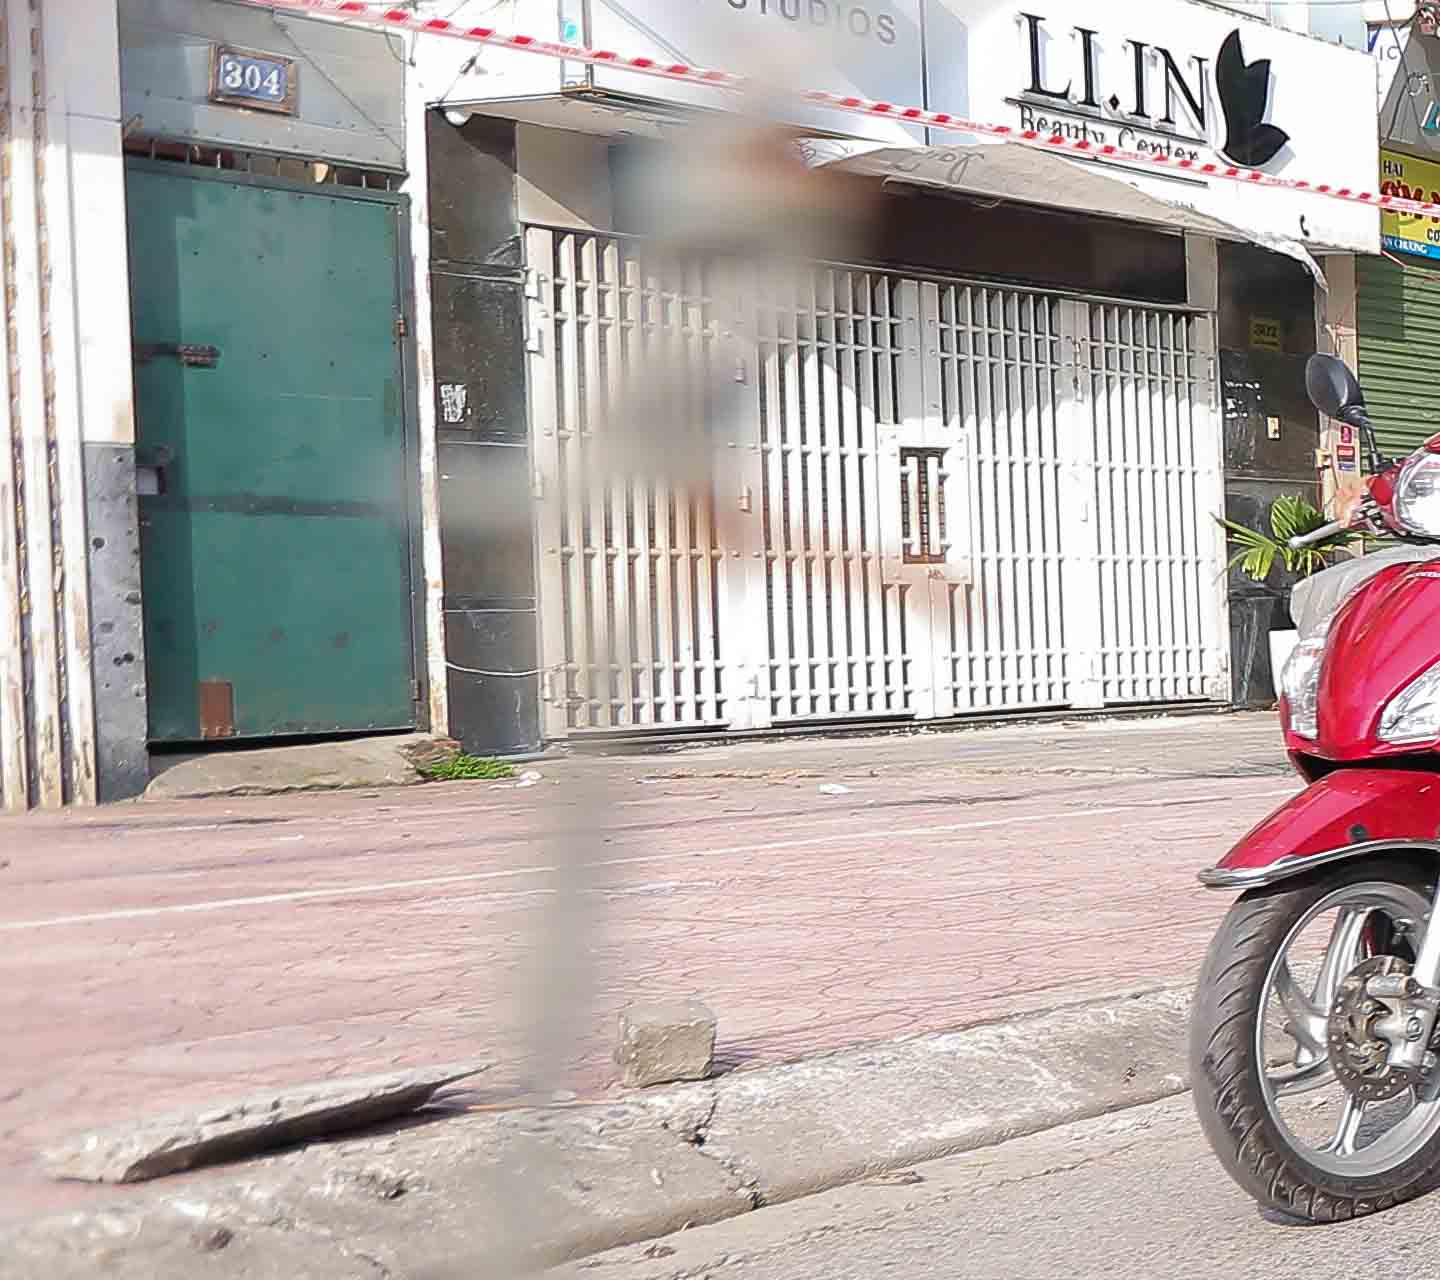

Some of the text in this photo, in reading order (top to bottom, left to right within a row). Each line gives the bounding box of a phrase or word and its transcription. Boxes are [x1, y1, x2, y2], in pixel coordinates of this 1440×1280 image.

[224, 60, 282, 96] 304
[1019, 11, 1209, 132] LI.IN
[1016, 102, 1200, 162] Beauty Center
